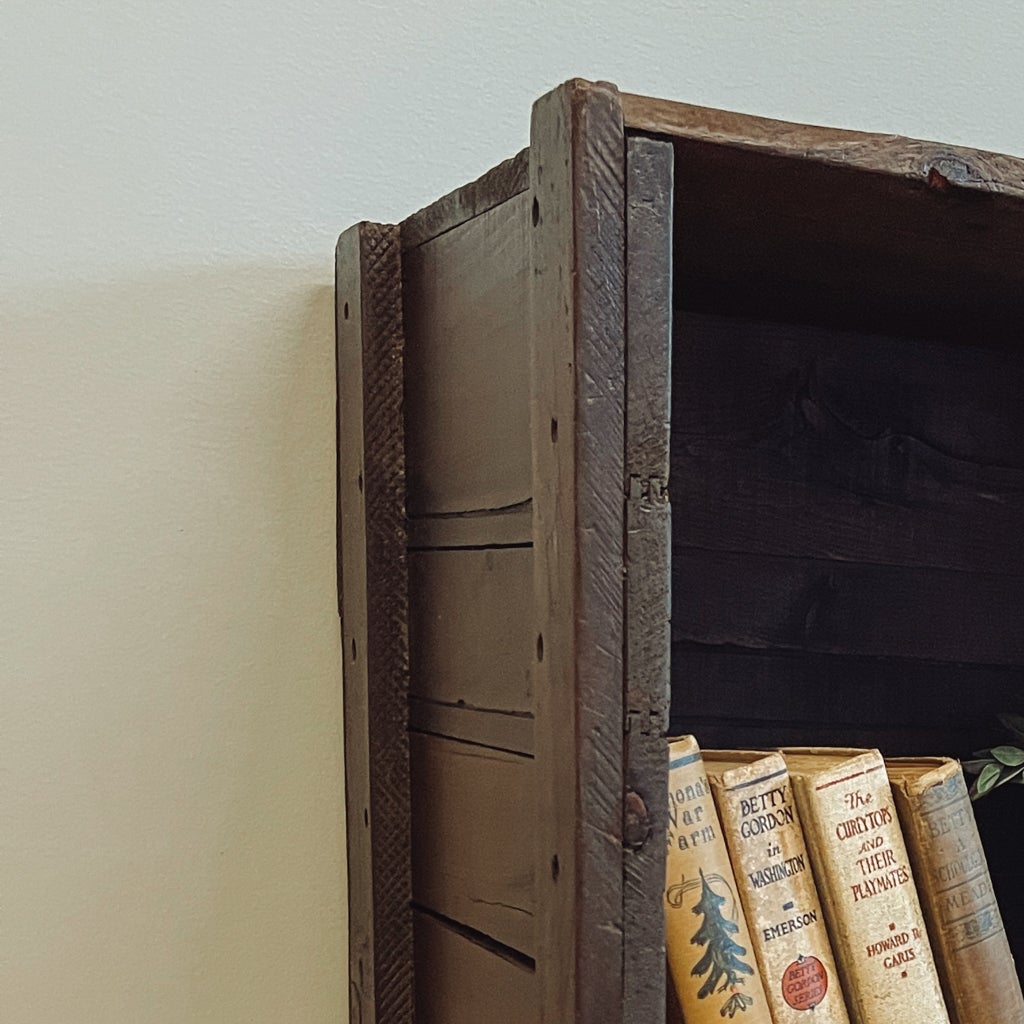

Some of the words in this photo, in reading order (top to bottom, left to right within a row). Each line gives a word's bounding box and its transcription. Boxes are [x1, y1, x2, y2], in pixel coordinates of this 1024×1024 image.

[740, 785, 788, 818] BETTY
[845, 790, 872, 810] The
[740, 805, 795, 839] GORDON
[666, 825, 716, 851] arm
[766, 842, 782, 858] in
[858, 836, 884, 855] AND
[749, 854, 806, 890] WASHINGTON
[856, 849, 897, 876] THEIR
[851, 865, 910, 902] PLAYMATES
[762, 909, 818, 942] EMERSON
[866, 932, 909, 958] HOWARD
[883, 948, 916, 970] GARIS
